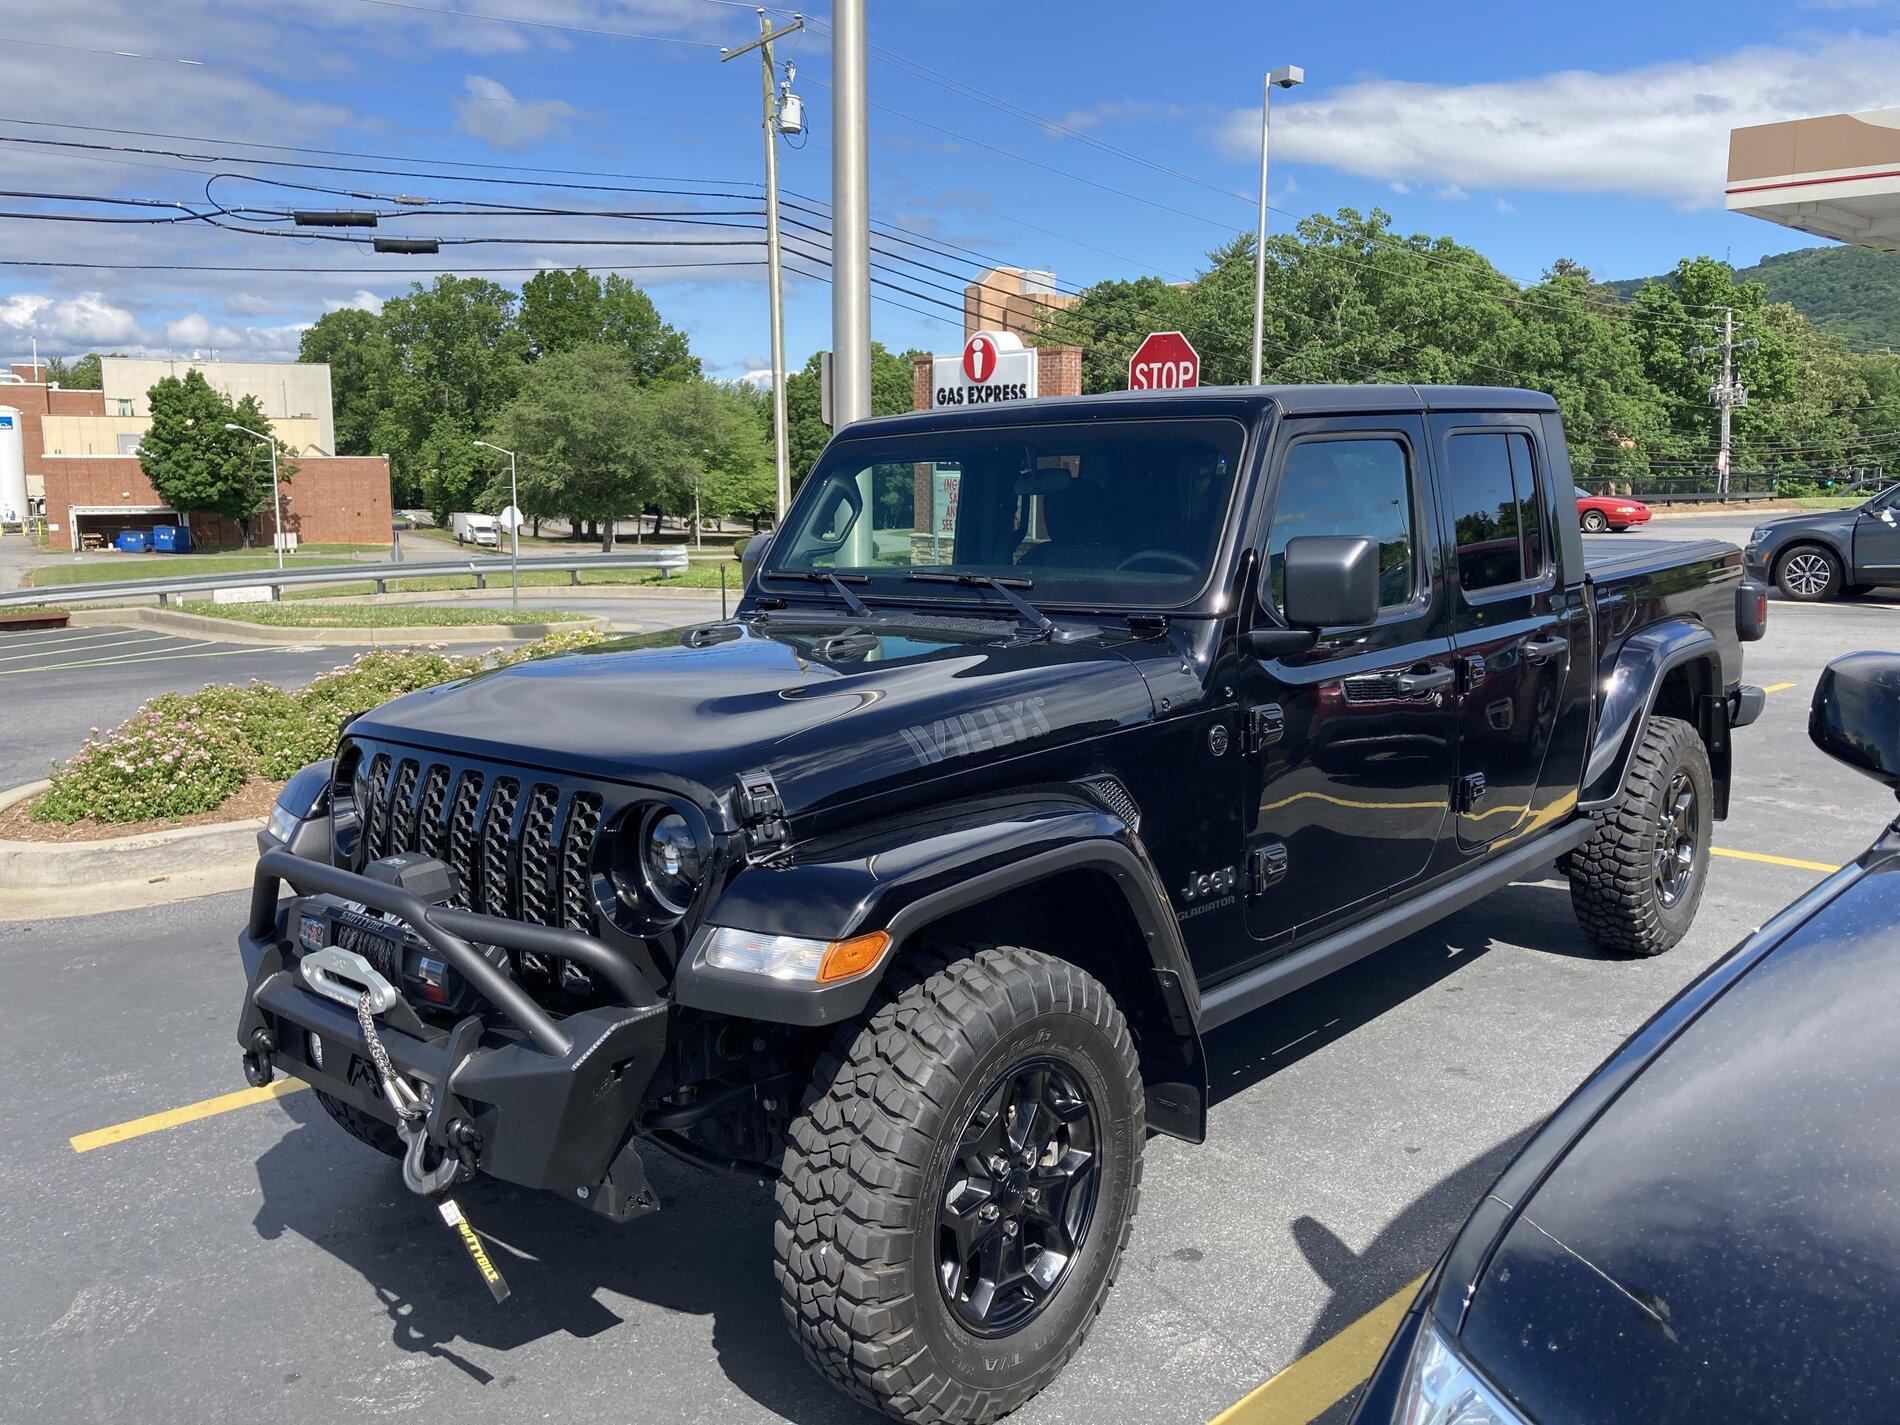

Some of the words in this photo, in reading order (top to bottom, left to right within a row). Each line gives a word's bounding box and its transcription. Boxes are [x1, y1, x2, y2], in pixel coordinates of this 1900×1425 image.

[1133, 361, 1194, 390] STOP
[936, 387, 964, 405] GAS
[967, 383, 1027, 404] EXPRESS
[943, 478, 960, 491] ING
[899, 696, 1051, 766] WILLYS
[1181, 866, 1235, 901] Jeep
[1176, 895, 1236, 920] GLADIATOR
[340, 911, 389, 933] SMITTYBILT
